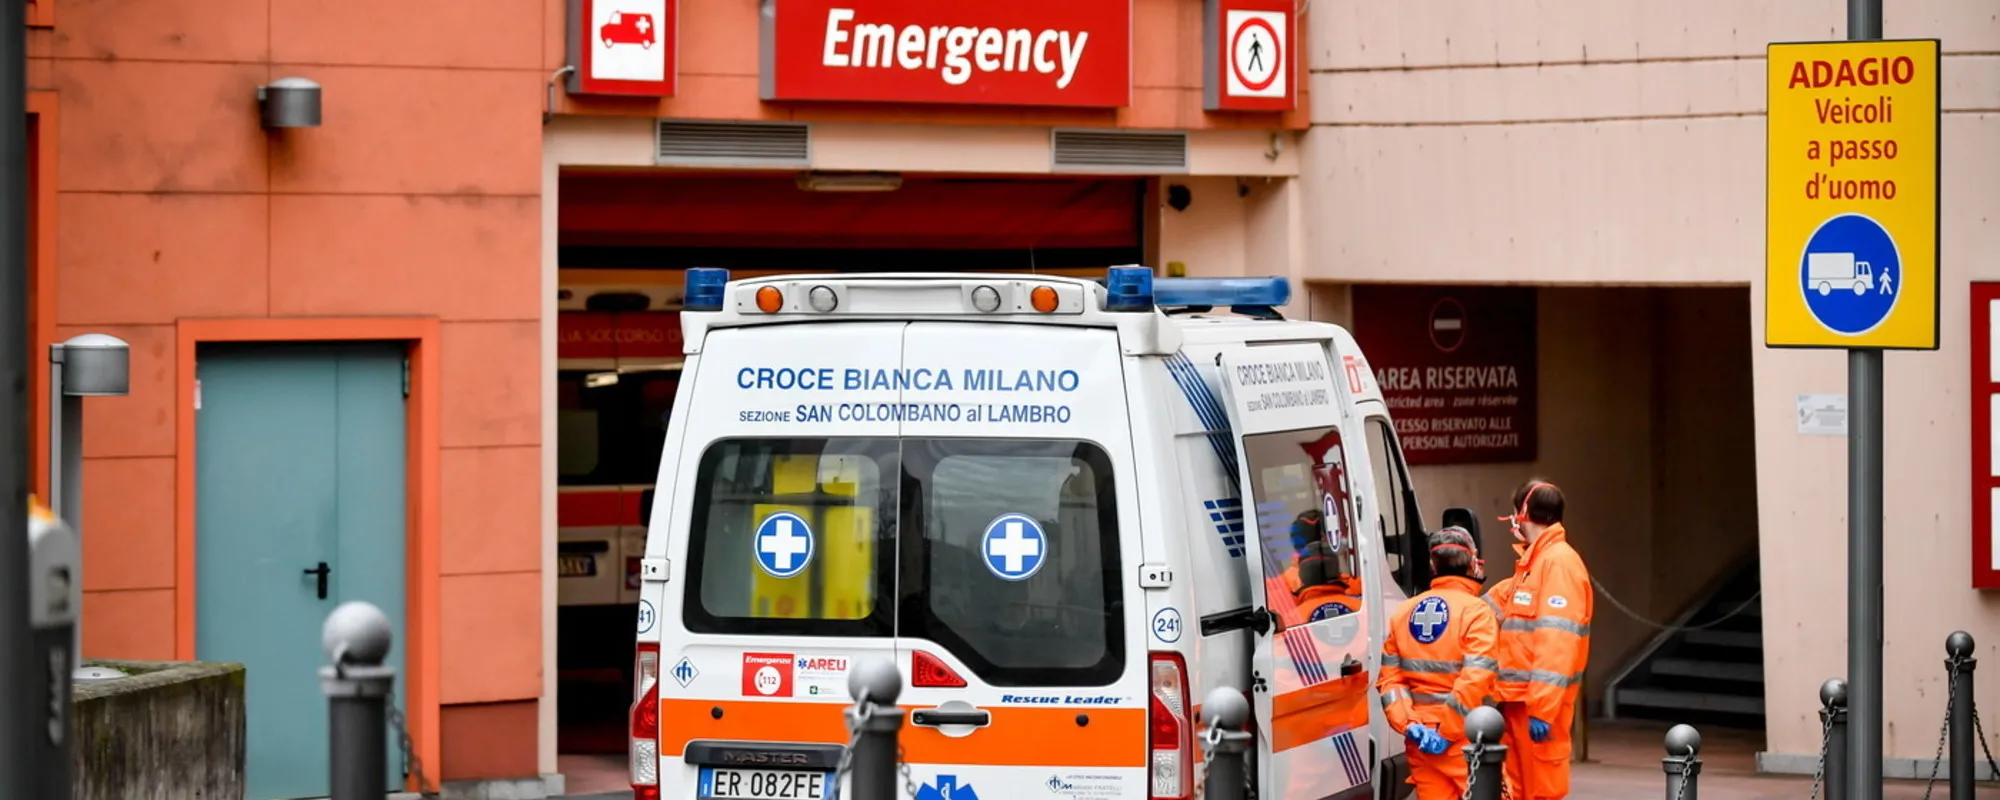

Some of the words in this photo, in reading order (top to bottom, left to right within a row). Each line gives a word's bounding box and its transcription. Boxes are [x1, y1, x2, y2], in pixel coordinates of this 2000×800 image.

[822, 7, 1089, 90] Emergency
[1788, 56, 1915, 90] ADAGIO
[1815, 96, 1893, 124] Veicoli
[1807, 139, 1821, 160] a
[1829, 139, 1898, 167] passo
[1805, 172, 1896, 200] d'uomo
[736, 367, 834, 390] CROCE
[843, 368, 953, 391] BIANCA
[963, 369, 1080, 392] MILANO
[1236, 362, 1267, 386] CROCE
[1265, 361, 1297, 384] BIANCA
[1294, 360, 1325, 381] MILANO
[1377, 367, 1422, 390] AREA
[1426, 365, 1518, 389] RISERVATA
[739, 410, 790, 422] SEZIONE
[796, 404, 832, 422] SAN
[838, 403, 961, 423] COLOMBANO
[966, 404, 982, 422] al
[987, 404, 1071, 424] LAMBRO
[1393, 418, 1429, 433] CESSO
[1431, 417, 1486, 432] RISERVATO
[1489, 416, 1512, 430] ALLE
[1402, 436, 1450, 450] PERSONE
[1452, 434, 1519, 449] AUTORIZZATE
[640, 609, 651, 624] 41
[1157, 617, 1180, 632] 241
[745, 656, 792, 665] Emergenza
[806, 658, 847, 671] AREU
[762, 676, 777, 685] 112
[1001, 694, 1060, 704] Rescue
[1064, 695, 1122, 705] Leader
[723, 750, 808, 764] MASTER
[714, 771, 741, 796] ER
[750, 772, 822, 798] 082FE
